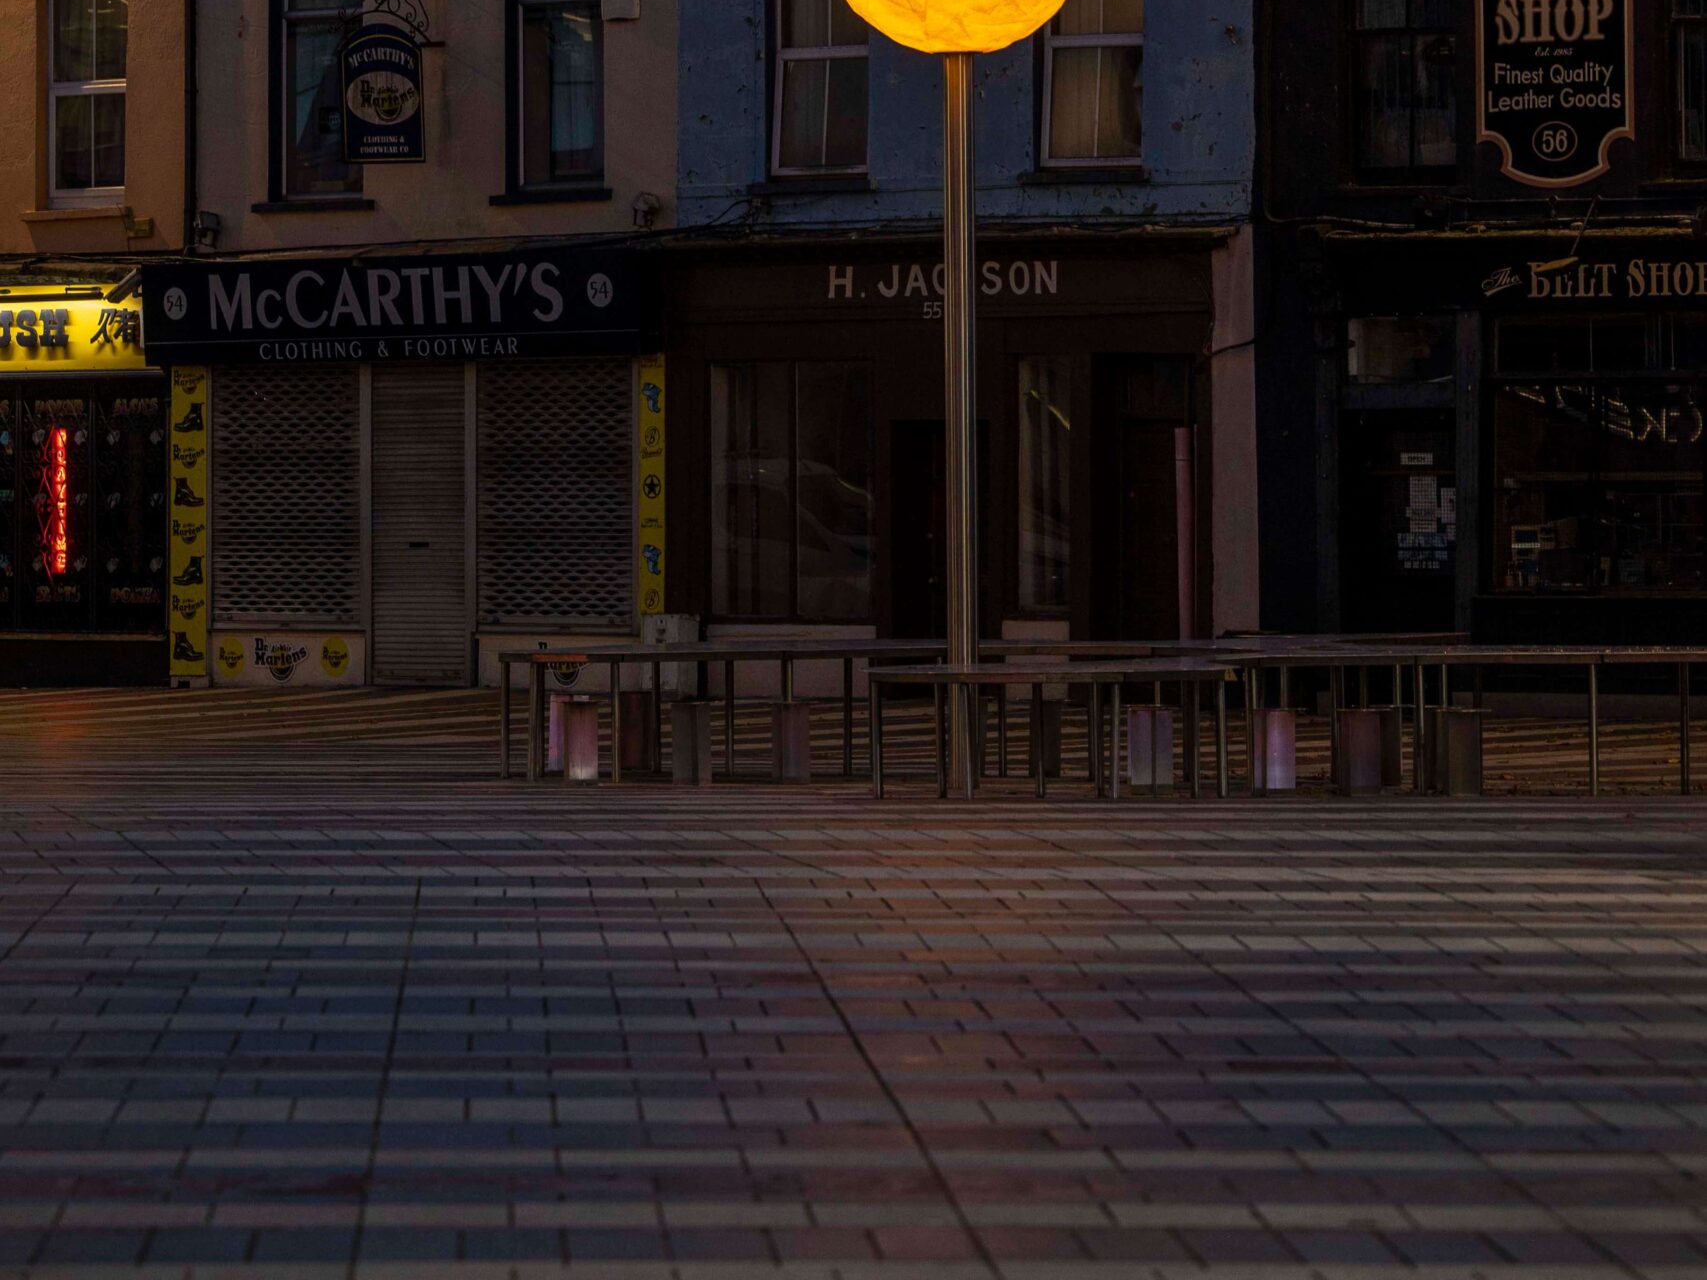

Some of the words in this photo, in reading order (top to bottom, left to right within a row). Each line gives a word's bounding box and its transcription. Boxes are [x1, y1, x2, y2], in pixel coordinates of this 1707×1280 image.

[1494, 63, 1545, 86] Finest
[1549, 60, 1615, 88] Quality
[360, 87, 415, 109] Martens
[1488, 91, 1554, 114] Leather
[1559, 85, 1622, 110] Goods
[1541, 129, 1569, 154] 56
[828, 265, 866, 299] H.
[877, 259, 1059, 299] JACSON
[1481, 266, 1524, 297] The
[167, 294, 184, 312] 54
[208, 261, 564, 334] McCARTHY'S
[590, 280, 610, 299] 54
[923, 301, 943, 320] 55
[259, 339, 363, 361] CLOTHING
[377, 339, 390, 358] &
[404, 336, 519, 358] FOOTWEAR
[255, 646, 307, 666] Martens
